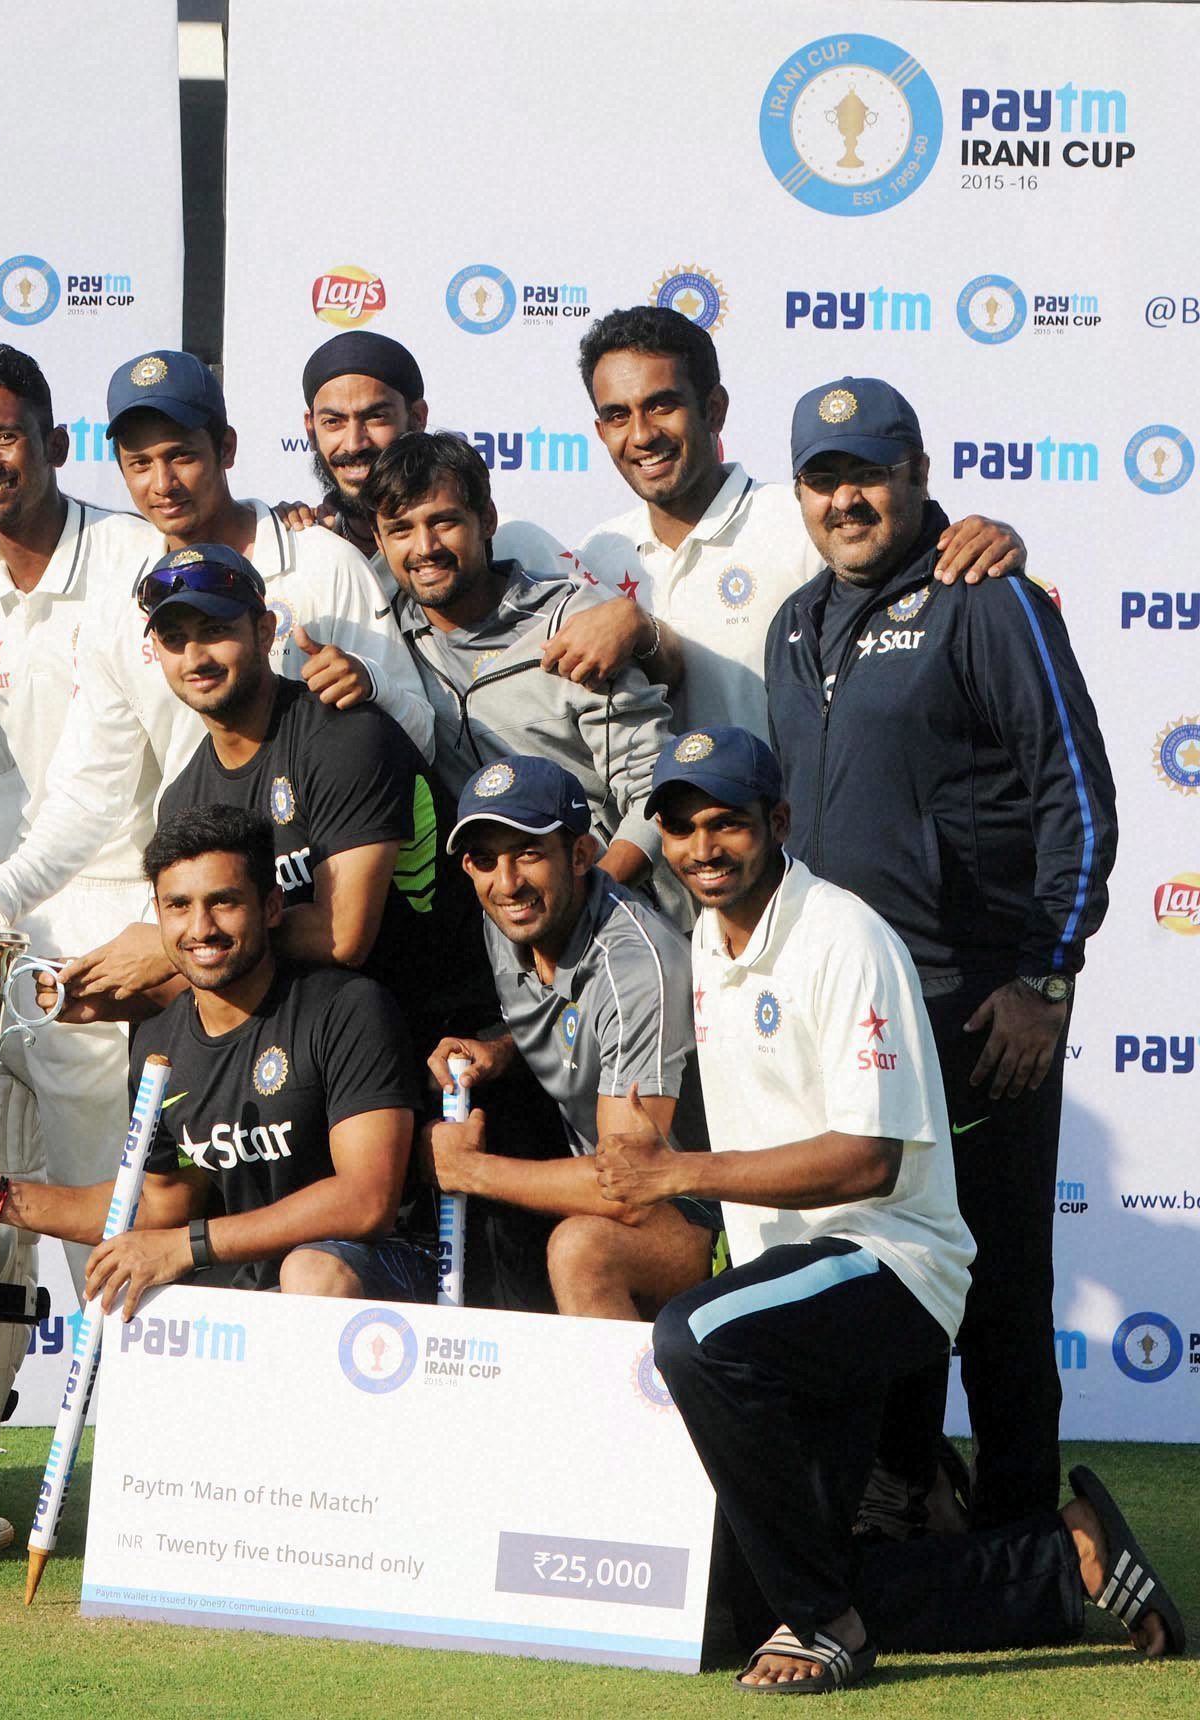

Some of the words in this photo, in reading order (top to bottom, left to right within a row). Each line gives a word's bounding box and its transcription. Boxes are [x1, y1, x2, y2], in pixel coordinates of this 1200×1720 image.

[768, 62, 807, 118] IRANI
[808, 40, 850, 67] CUP
[961, 139, 1050, 167] IRANI
[1062, 141, 1136, 168] CUP
[68, 296, 102, 306] IRANI
[106, 296, 134, 306] CUP
[523, 306, 558, 317] IRANI
[563, 306, 590, 318] CUP
[1034, 315, 1068, 327] IRANI
[1072, 315, 1101, 327] CUP
[878, 629, 925, 654] Star
[857, 1049, 897, 1070] Star
[211, 1120, 293, 1170] Star
[1060, 1203, 1088, 1213] CUP
[424, 1361, 464, 1377] IRANI
[469, 1364, 502, 1379] CUP
[122, 1475, 184, 1499] Paytm
[244, 1486, 266, 1504] of
[270, 1488, 303, 1507] the
[117, 1534, 143, 1549] INR
[156, 1534, 228, 1562] Twenty
[233, 1540, 270, 1561] five
[276, 1545, 374, 1571] thousand
[380, 1556, 425, 1580] only
[95, 1588, 121, 1600] Paytm
[123, 1591, 149, 1601] Wallet
[159, 1595, 186, 1605] issued
[188, 1597, 198, 1607] by
[228, 1601, 300, 1615] Communications
[301, 1607, 318, 1617] Ltd.
